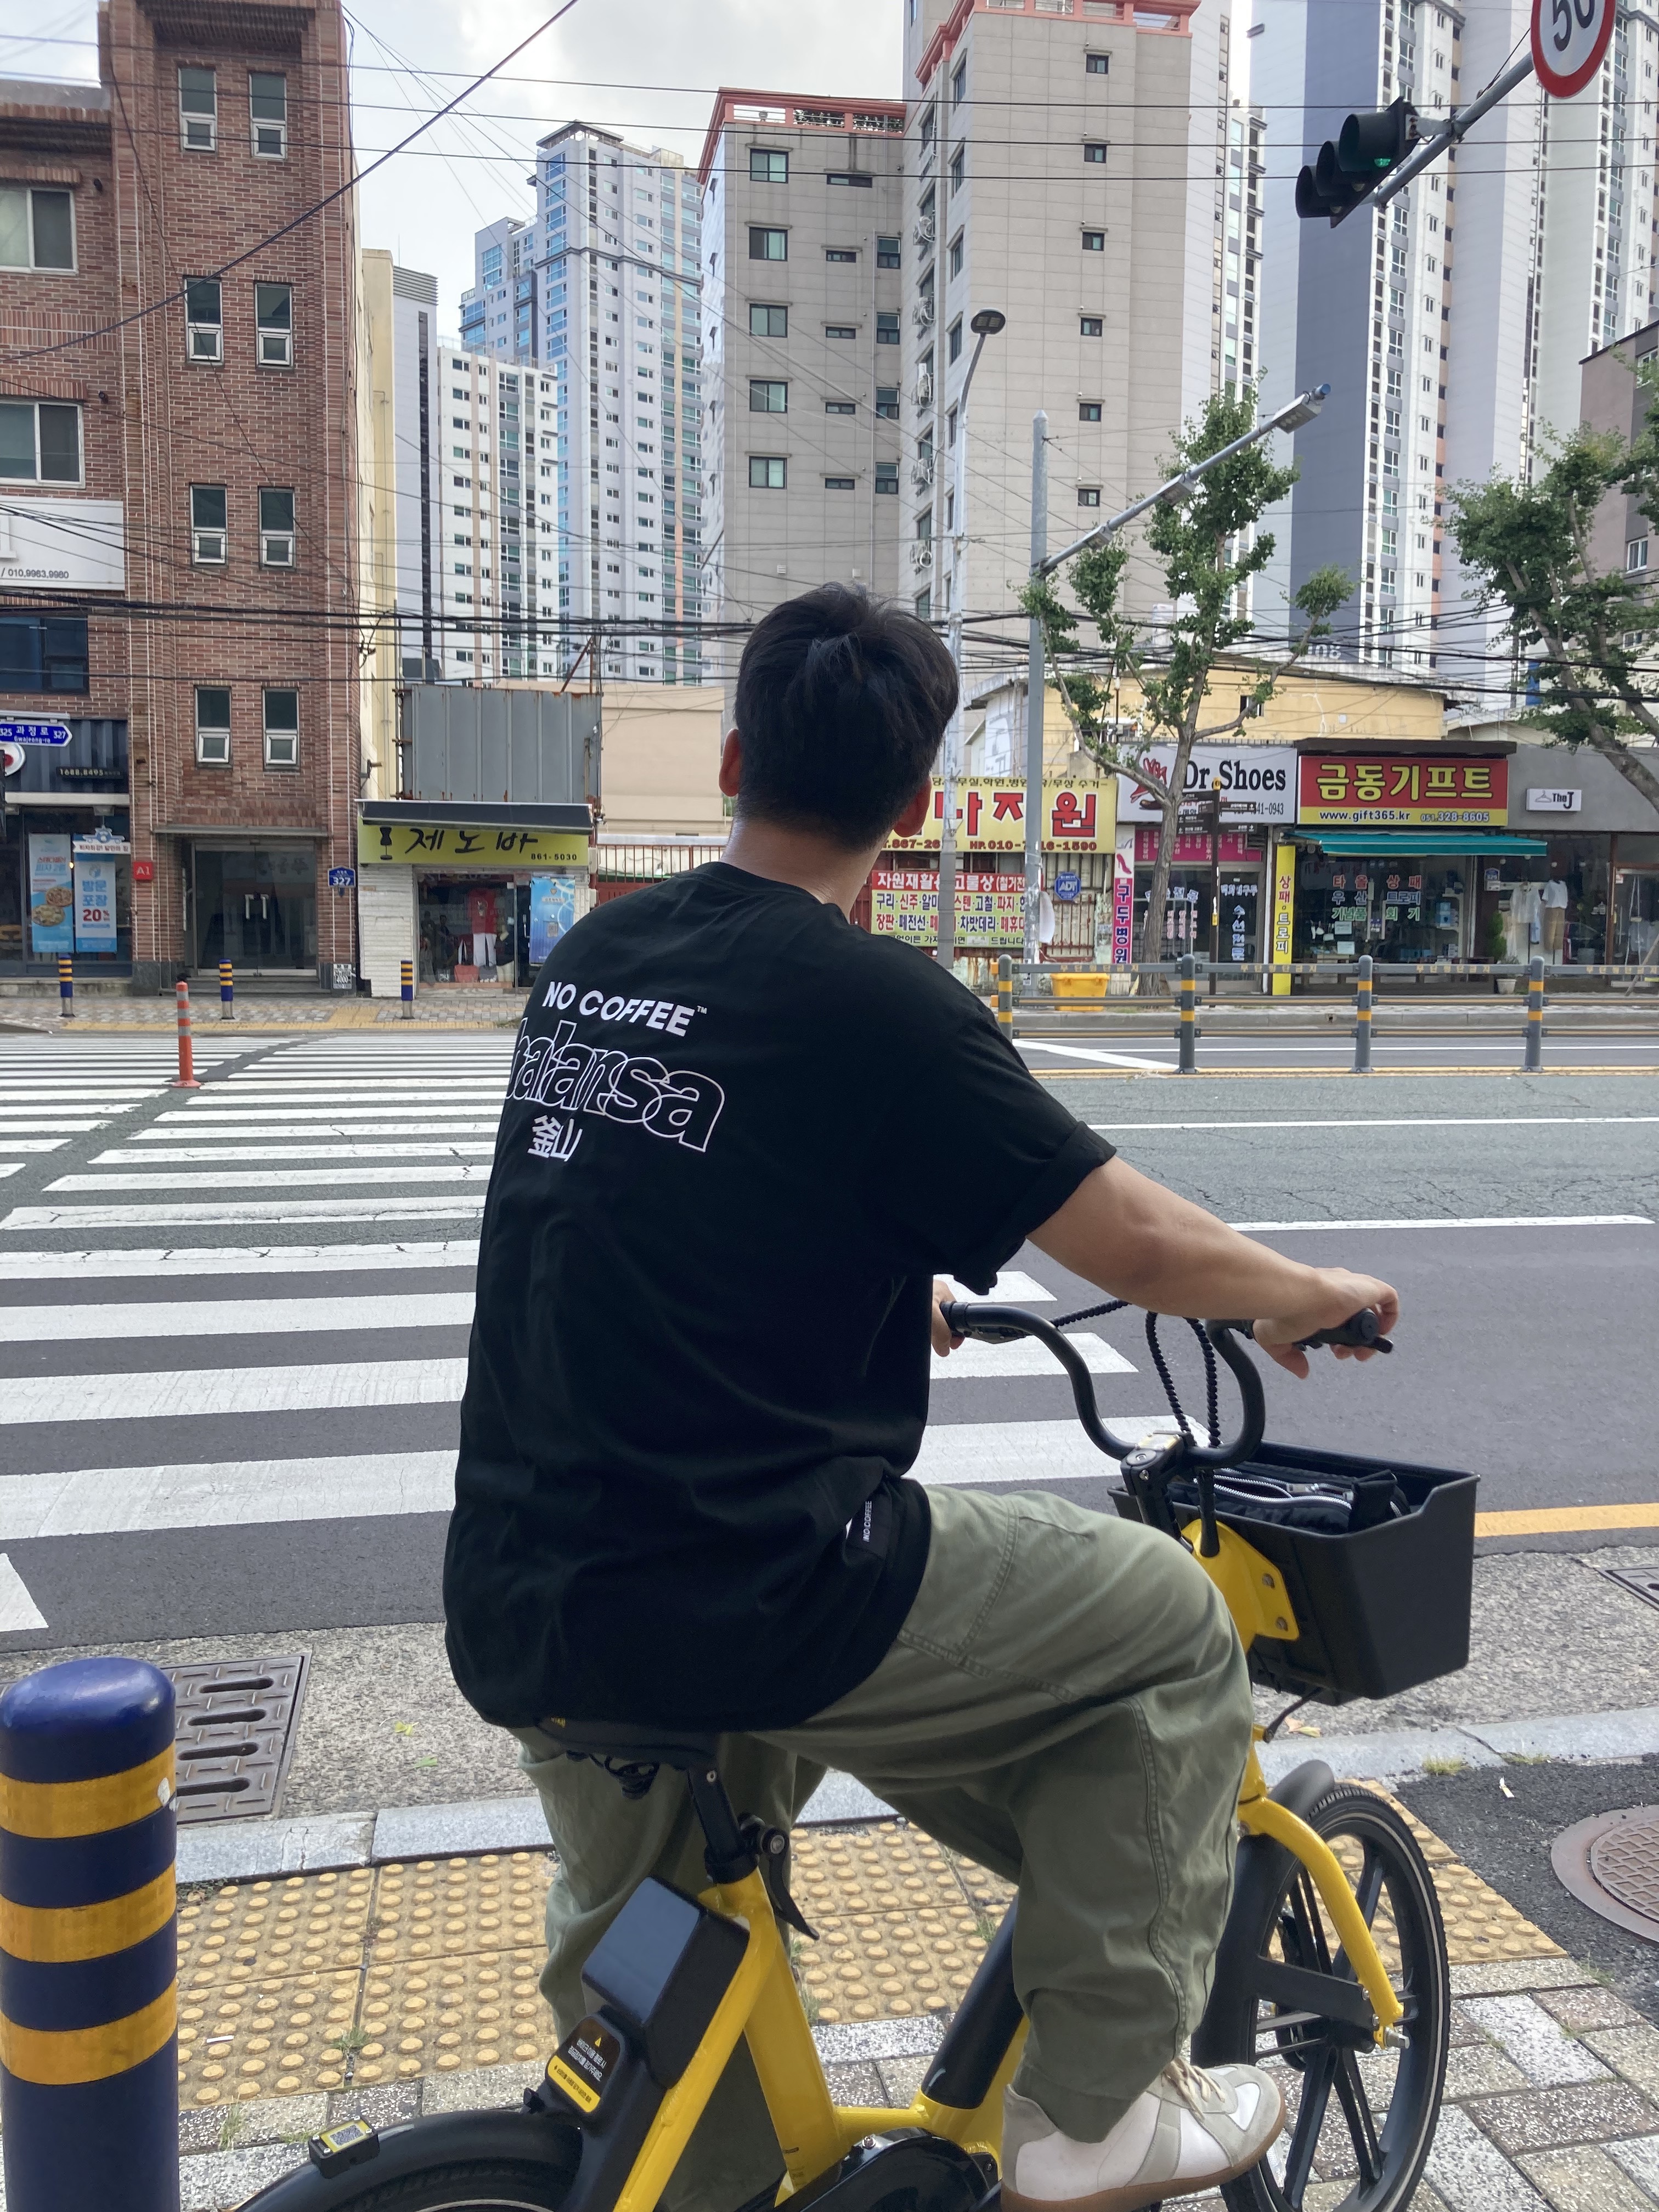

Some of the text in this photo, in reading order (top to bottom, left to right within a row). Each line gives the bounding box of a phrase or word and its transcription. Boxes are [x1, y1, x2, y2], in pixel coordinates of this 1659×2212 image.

[16, 725, 49, 736] 과정로
[53, 730, 66, 739] 327
[1317, 763, 1493, 802] 금동기프트
[1319, 810, 1489, 822] www.gift365.kr 051.328-8605
[405, 828, 538, 854] 제노바
[332, 877, 351, 886] 327
[1059, 881, 1076, 891] ADT
[1331, 890, 1367, 905] 우산
[1386, 890, 1421, 906] 트로피
[1331, 906, 1367, 922] 기념품
[1115, 885, 1130, 964] 구두병원
[1276, 912, 1291, 954] 트로피
[543, 981, 577, 1010] NO
[527, 1115, 583, 1163] 釜山
[862, 1500, 872, 1542] NO COFFEE
